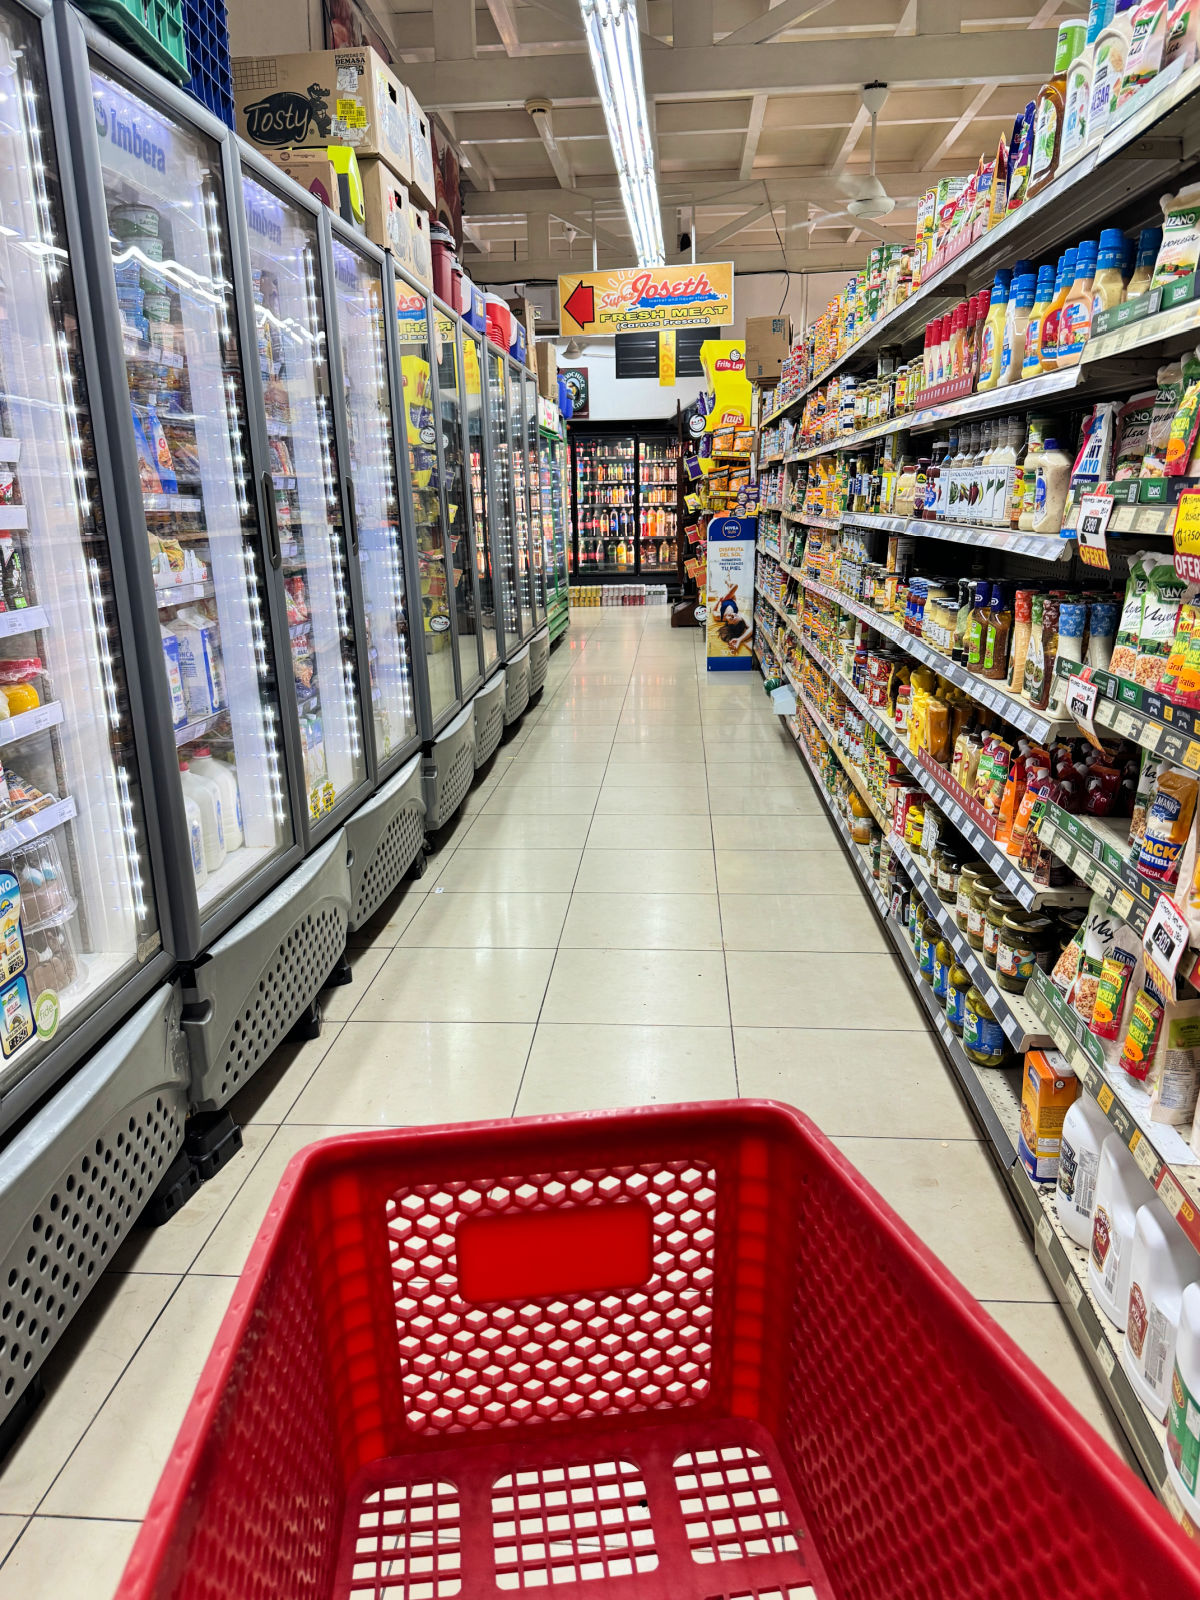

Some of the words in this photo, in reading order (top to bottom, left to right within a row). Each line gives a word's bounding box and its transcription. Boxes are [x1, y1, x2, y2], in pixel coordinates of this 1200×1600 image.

[244, 102, 308, 142] Tosty
[110, 108, 166, 174] Imbera
[598, 292, 636, 310] Super
[630, 274, 712, 306] Joseth
[600, 310, 665, 323] FRESH
[671, 305, 728, 318] MEAT
[616, 322, 660, 331] (Carnes
[664, 317, 710, 326] Frescas)
[716, 360, 731, 368] Frito
[732, 362, 744, 370] Lay
[1080, 546, 1110, 570] OFERTA
[895, 800, 904, 832] TOFU
